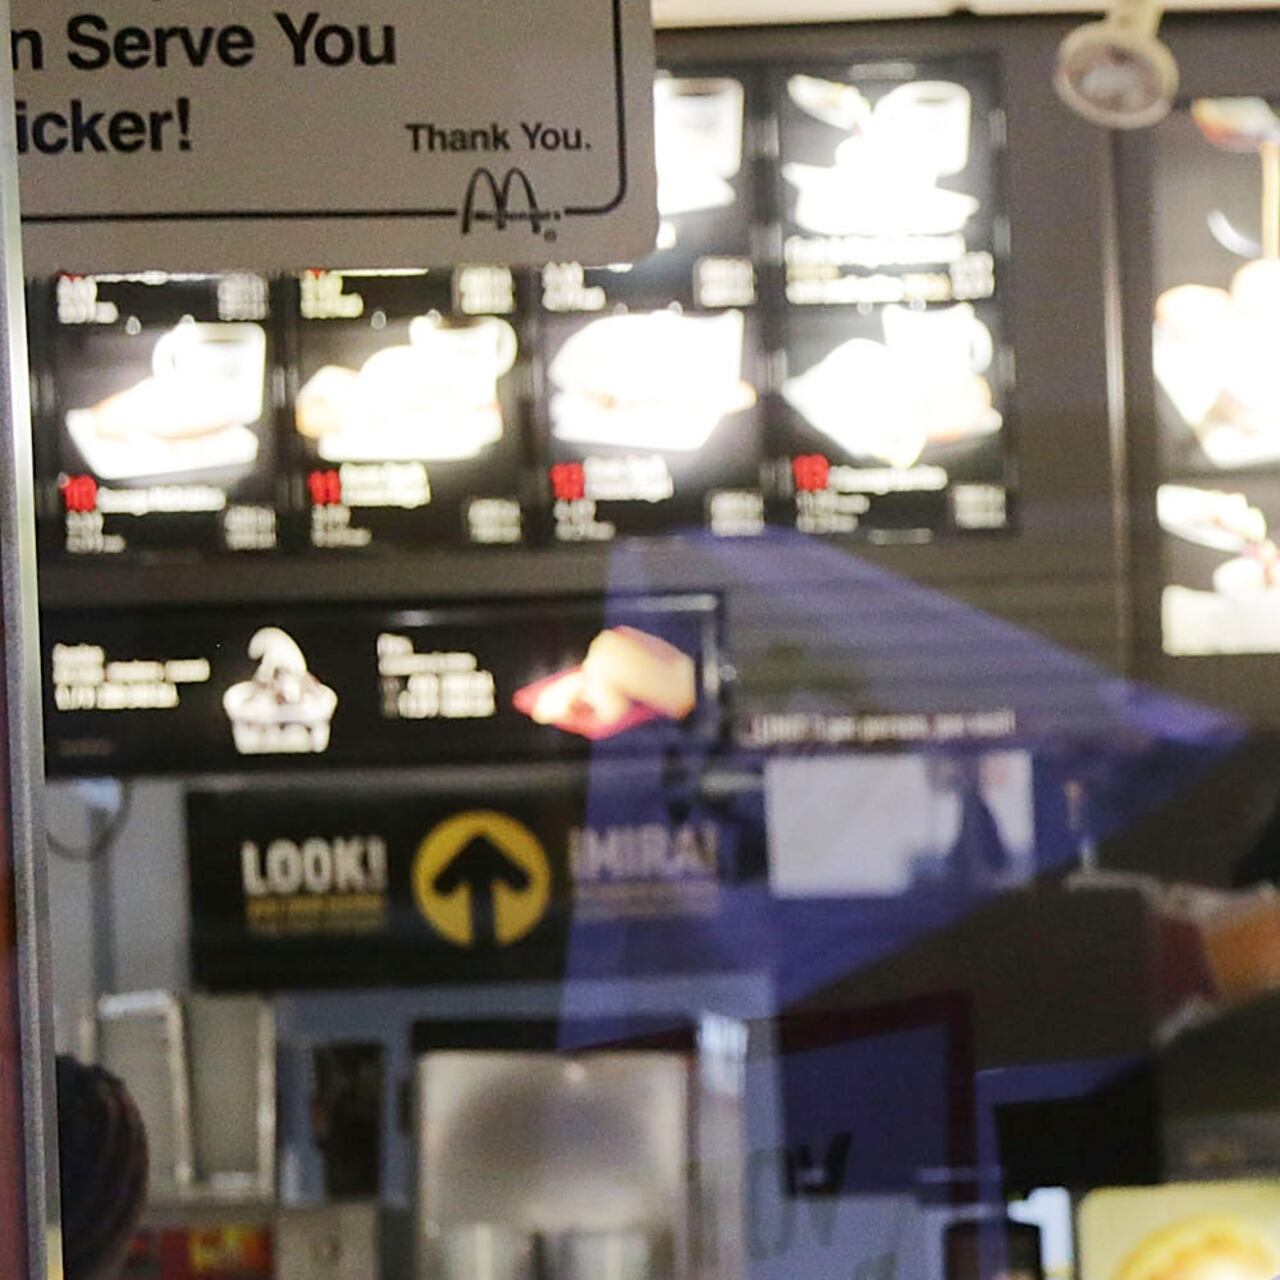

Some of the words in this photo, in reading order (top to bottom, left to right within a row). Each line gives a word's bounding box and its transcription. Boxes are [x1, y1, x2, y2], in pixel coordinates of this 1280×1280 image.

[66, 14, 255, 71] Serve
[273, 12, 396, 67] You
[405, 123, 510, 151] Thank
[520, 122, 592, 150] You.
[241, 836, 388, 896] LOOK!
